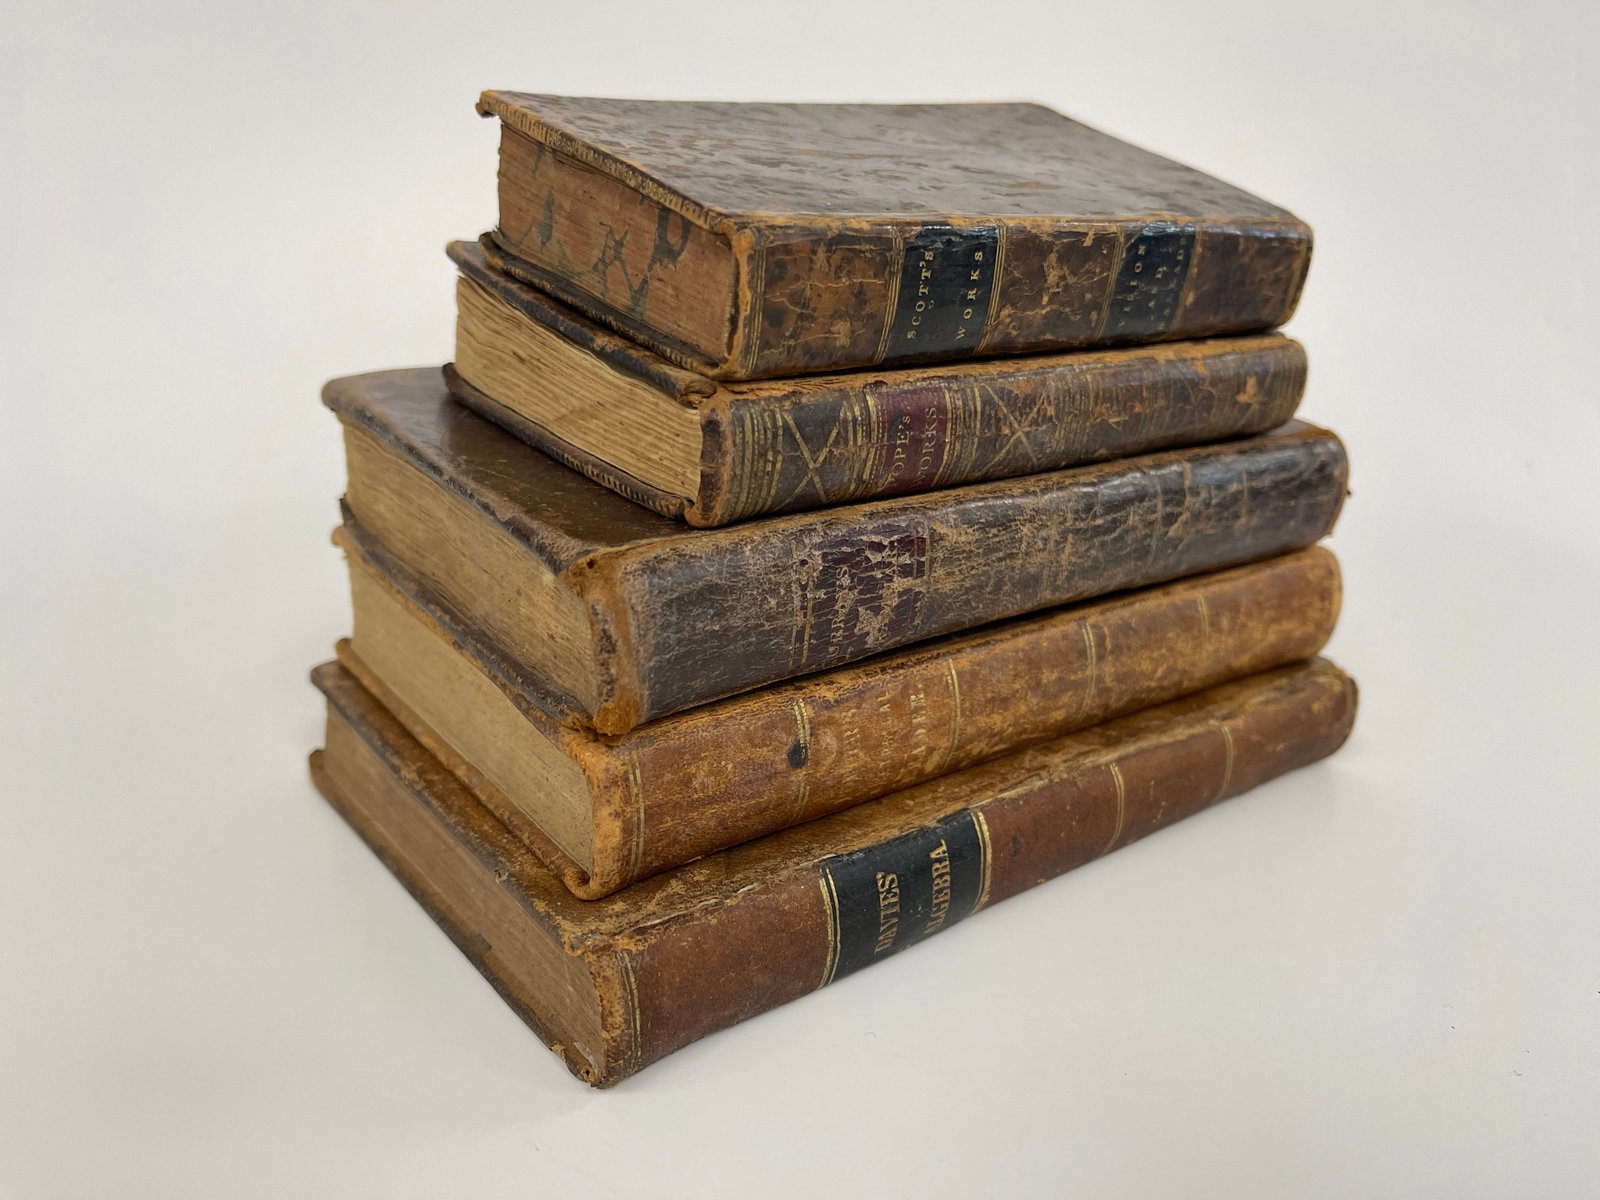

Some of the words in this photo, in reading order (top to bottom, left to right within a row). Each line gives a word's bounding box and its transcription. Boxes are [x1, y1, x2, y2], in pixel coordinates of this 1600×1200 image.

[907, 251, 934, 340] SCOTT'S
[955, 251, 983, 340] WORKS
[910, 407, 938, 488] WORKS
[827, 566, 852, 659] URRAY'S
[874, 871, 900, 955] DAVIES'
[923, 839, 951, 935] ALGEBRA
